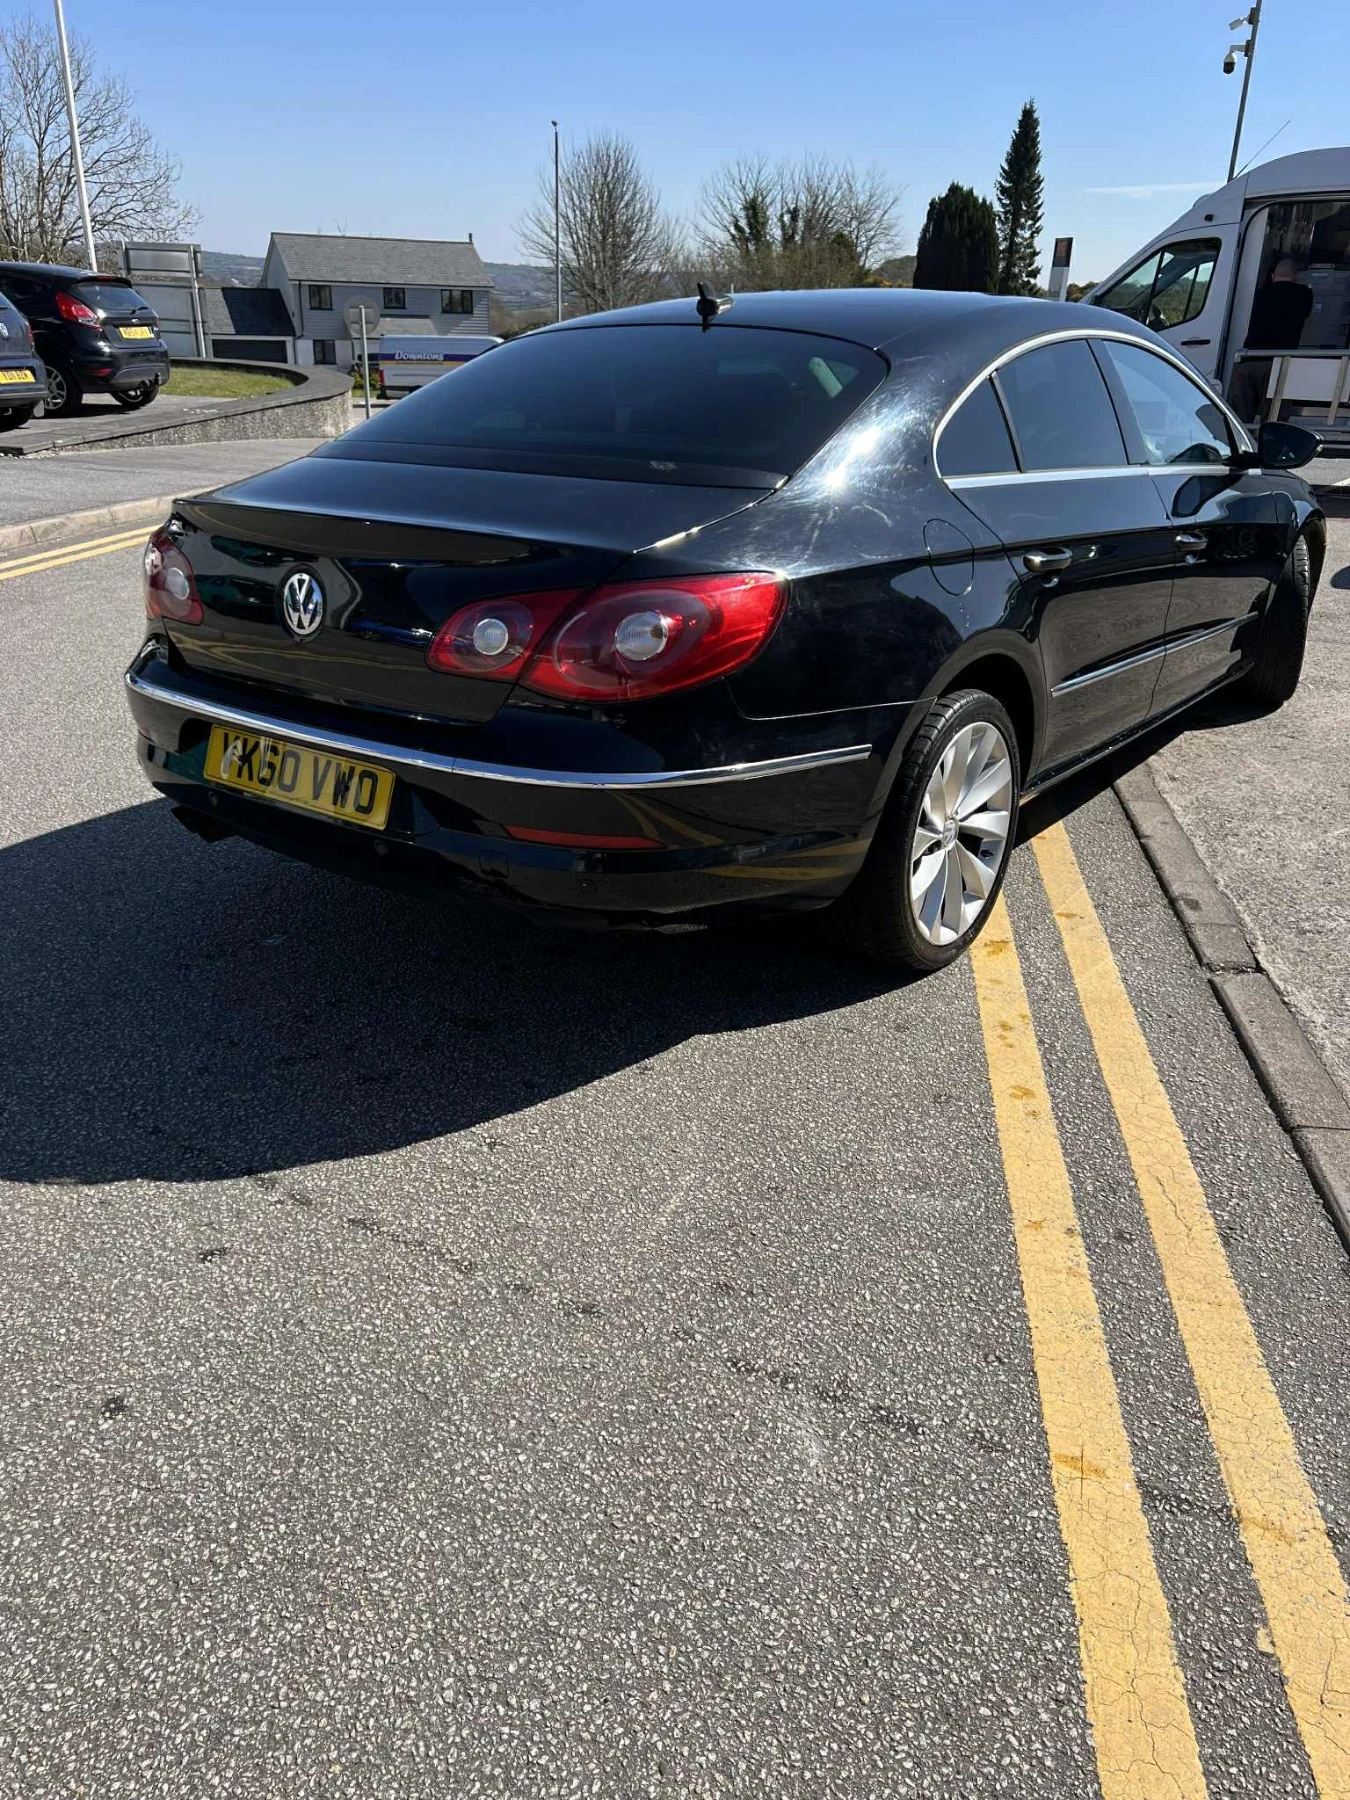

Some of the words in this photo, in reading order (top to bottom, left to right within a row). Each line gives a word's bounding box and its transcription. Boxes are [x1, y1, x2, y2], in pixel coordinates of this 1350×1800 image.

[394, 350, 444, 361] Downtons
[283, 572, 324, 635] VW
[312, 756, 379, 815] VWO
